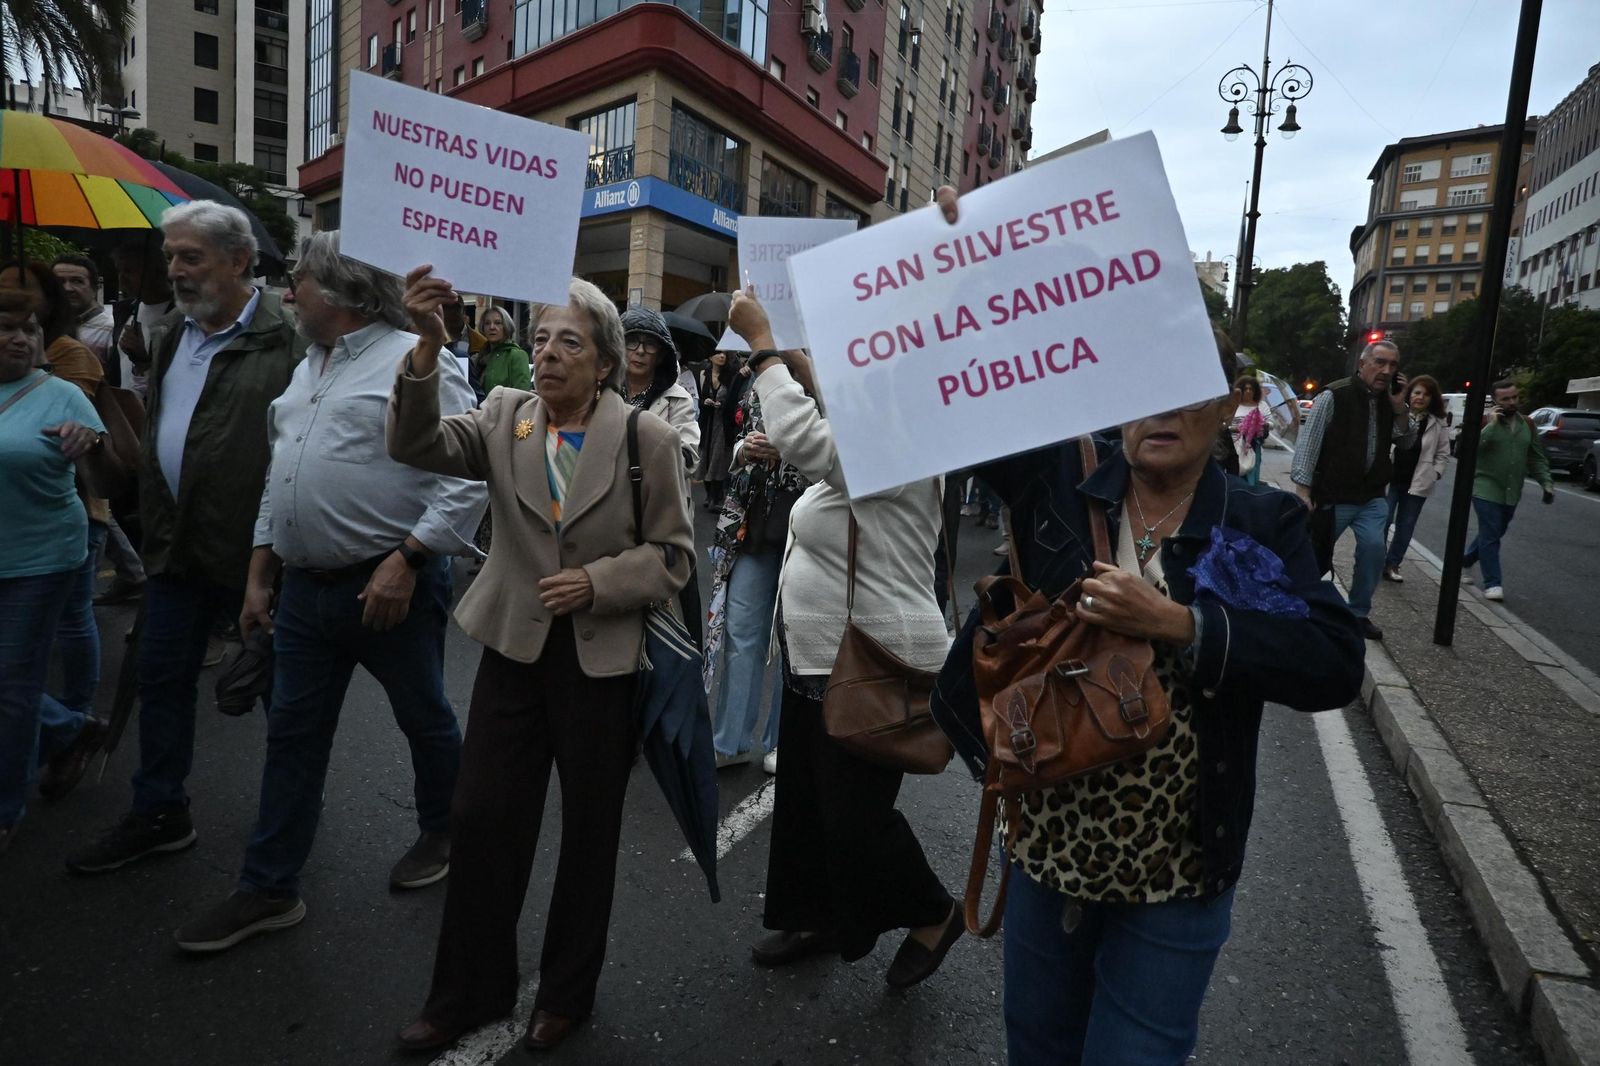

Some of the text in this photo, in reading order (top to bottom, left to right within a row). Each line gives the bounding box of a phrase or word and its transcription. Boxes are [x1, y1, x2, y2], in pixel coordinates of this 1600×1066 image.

[372, 109, 558, 180] NUESTRAS VIDAS
[394, 161, 525, 216] NO PUEDEN
[594, 189, 626, 209] Allianz
[402, 206, 498, 250] ESPERAR
[853, 190, 1121, 301] SAN SILVESTRE
[847, 248, 1162, 368] CON LA SANIDAD
[938, 336, 1099, 406] PÚBLICA
